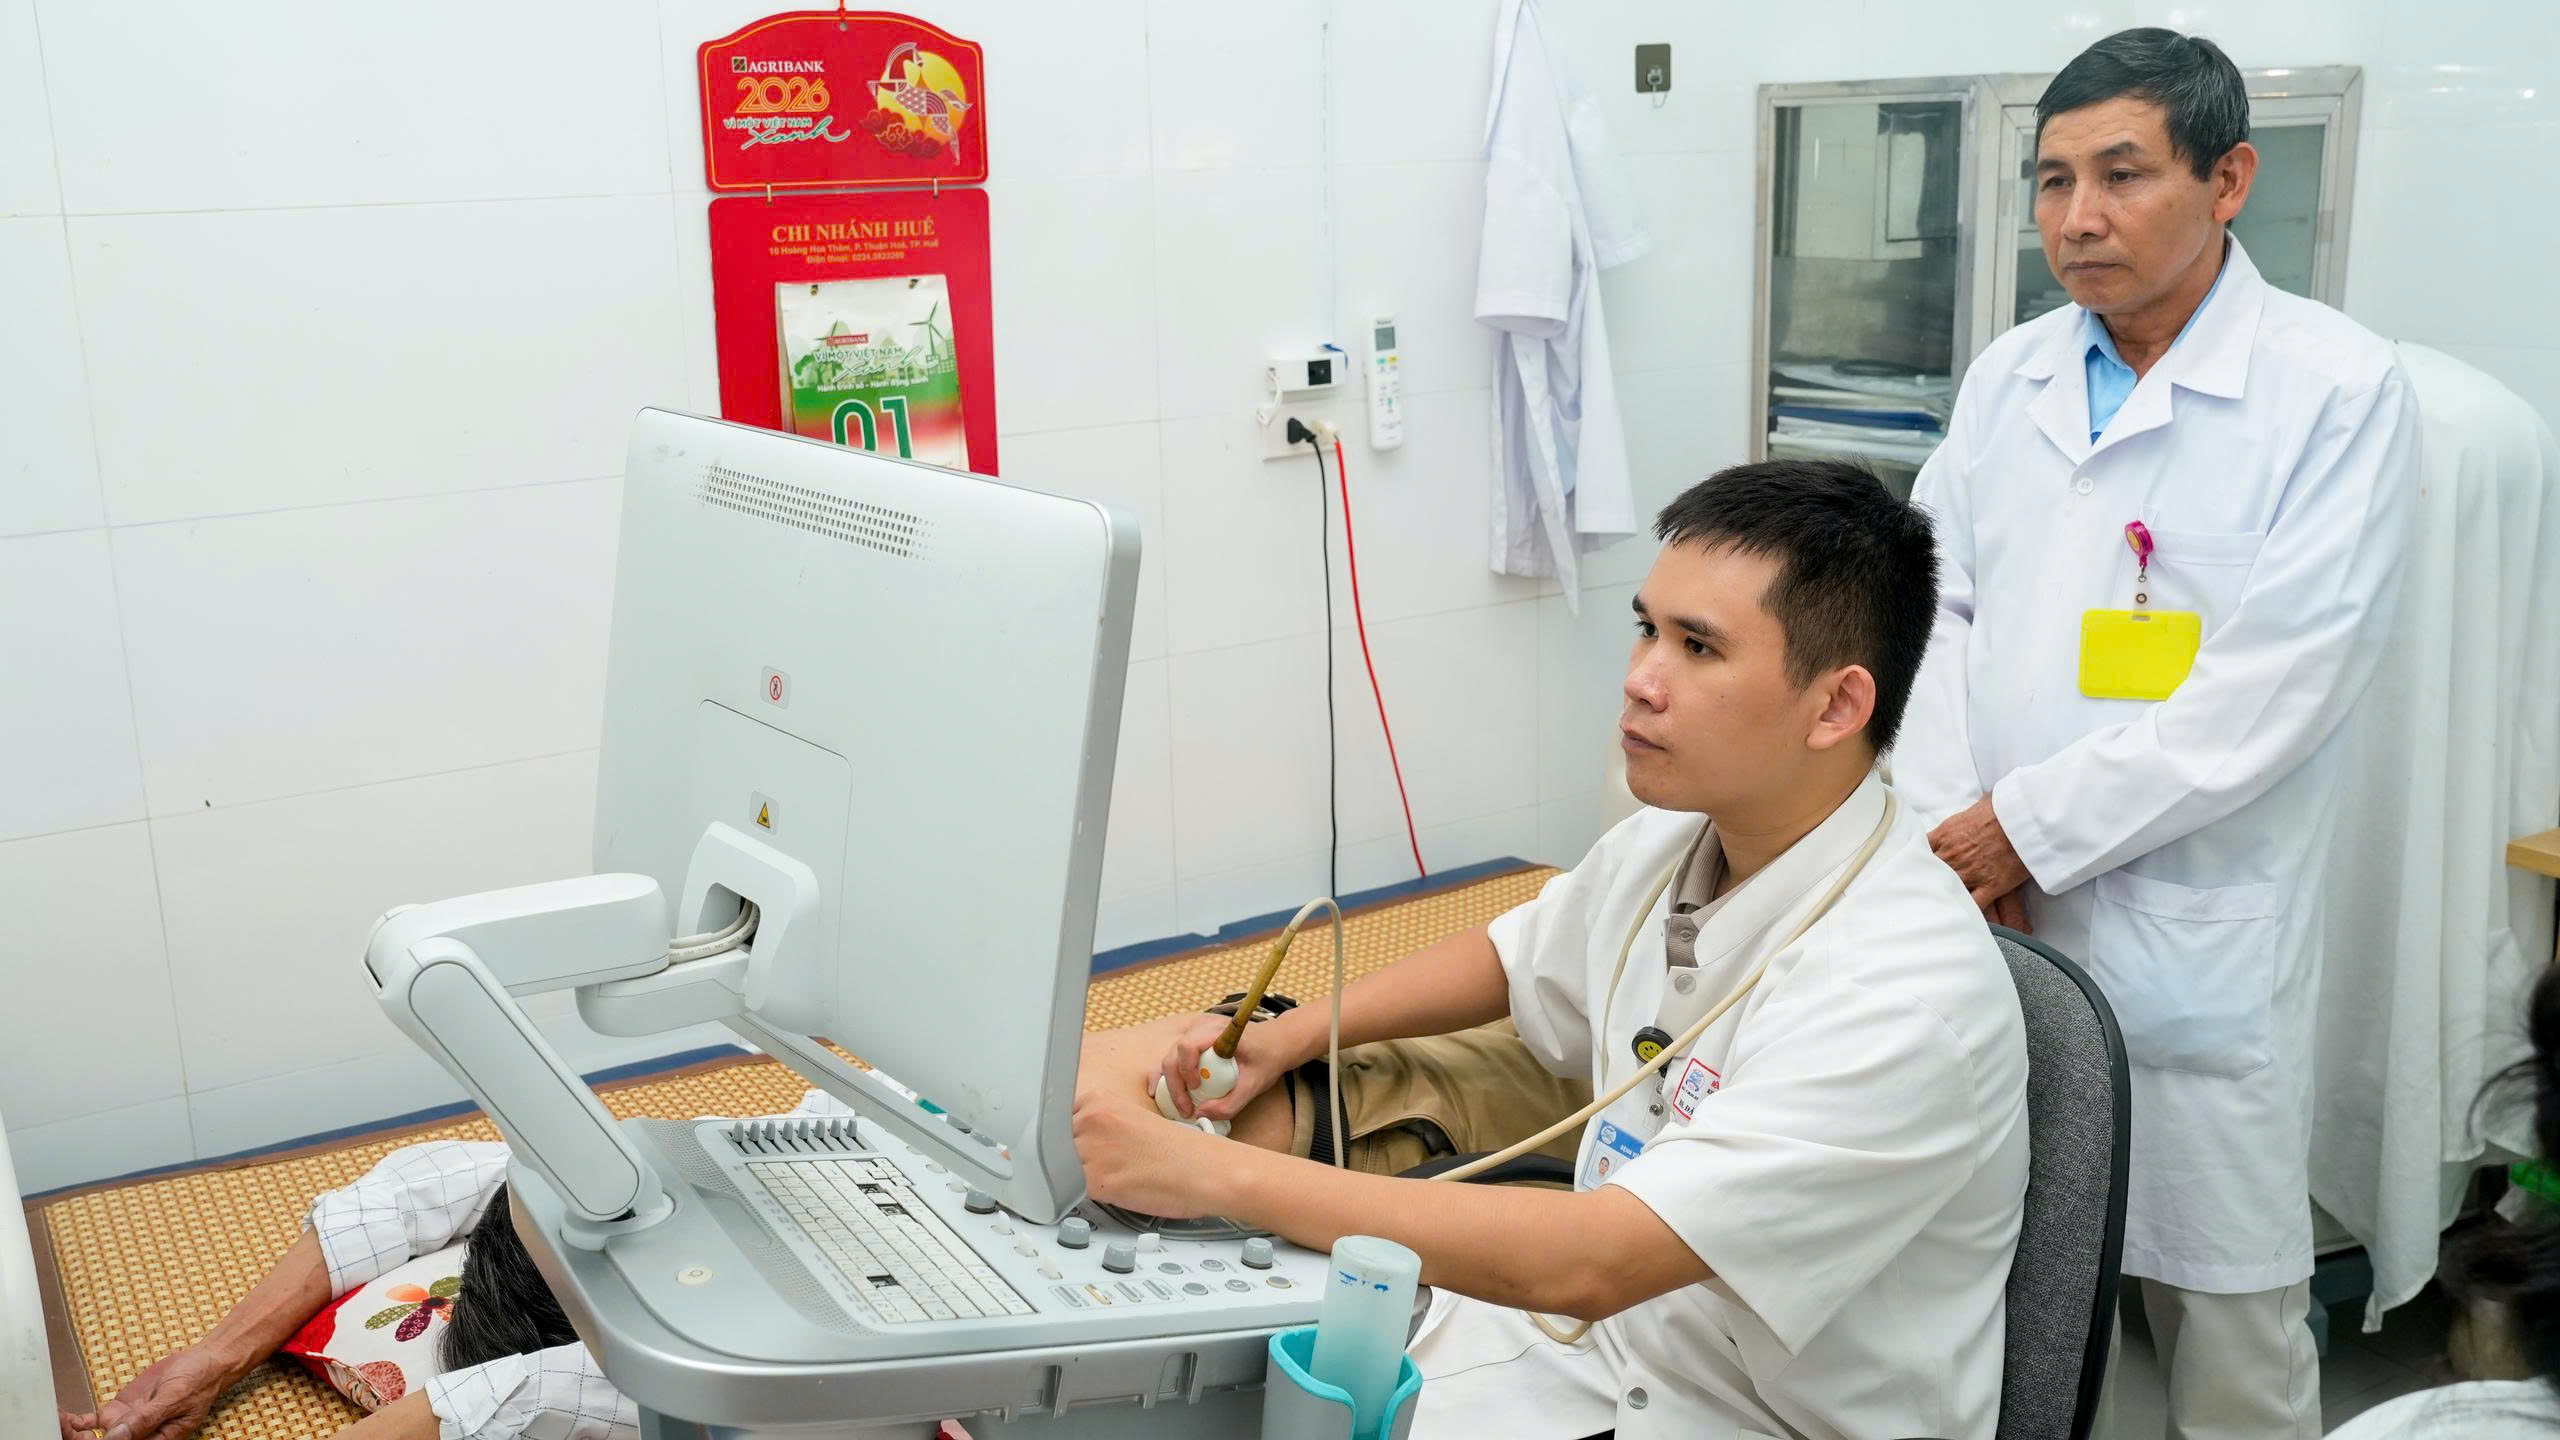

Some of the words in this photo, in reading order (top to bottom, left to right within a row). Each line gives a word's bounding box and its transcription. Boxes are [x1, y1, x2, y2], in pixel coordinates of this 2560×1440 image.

[748, 60, 824, 73] AGRIBANK
[736, 76, 830, 113] 2026
[723, 117, 736, 129] VÌ
[737, 116, 761, 130] MỘT
[762, 116, 786, 128] VIỆT
[787, 117, 812, 128] NAM
[772, 224, 810, 243] CHI
[816, 219, 888, 241] NHÁNH
[895, 215, 935, 237] HUẾ
[879, 346, 902, 356] NAM
[831, 395, 913, 460] 01
